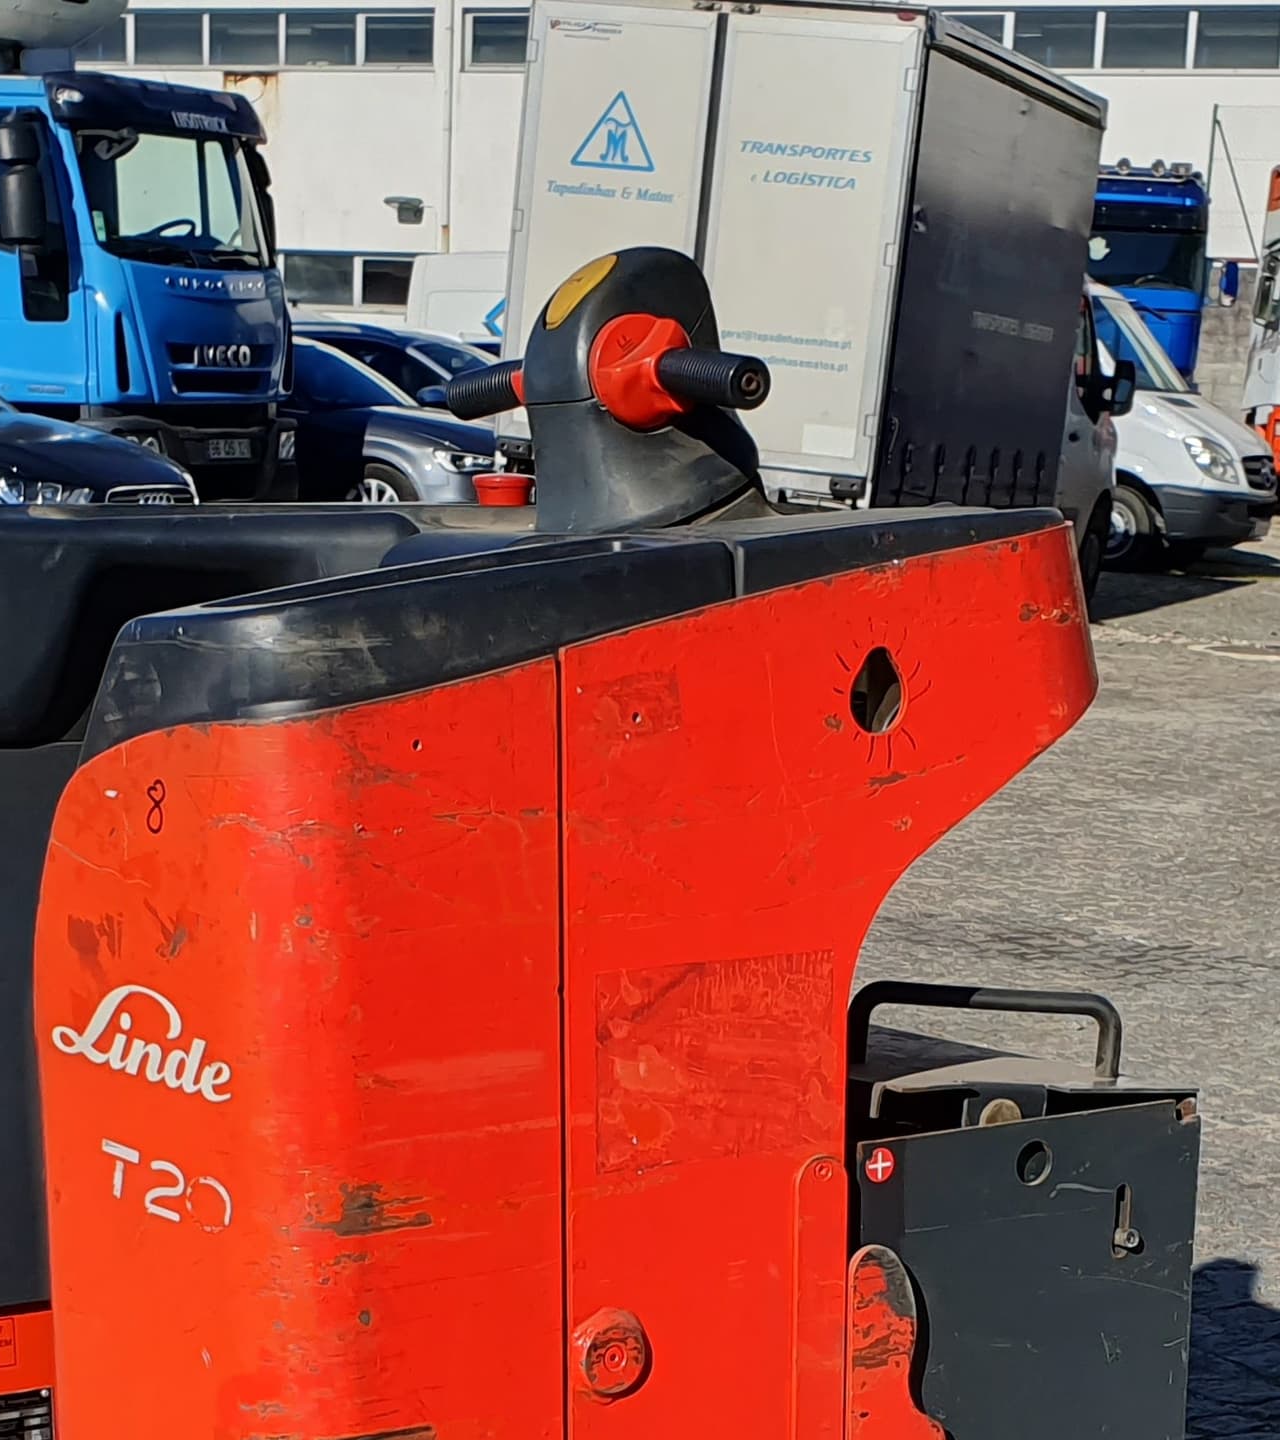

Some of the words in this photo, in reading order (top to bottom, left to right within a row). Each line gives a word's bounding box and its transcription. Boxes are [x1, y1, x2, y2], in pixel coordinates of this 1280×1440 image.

[171, 110, 229, 133] LUSOTRUCK
[740, 139, 873, 164] TRANSPORTES
[546, 180, 617, 197] Tapadinhas
[620, 186, 633, 200] &
[636, 187, 674, 203] Matos
[193, 345, 252, 367] IVECO
[146, 778, 166, 834] 8
[51, 984, 232, 1103] Linde
